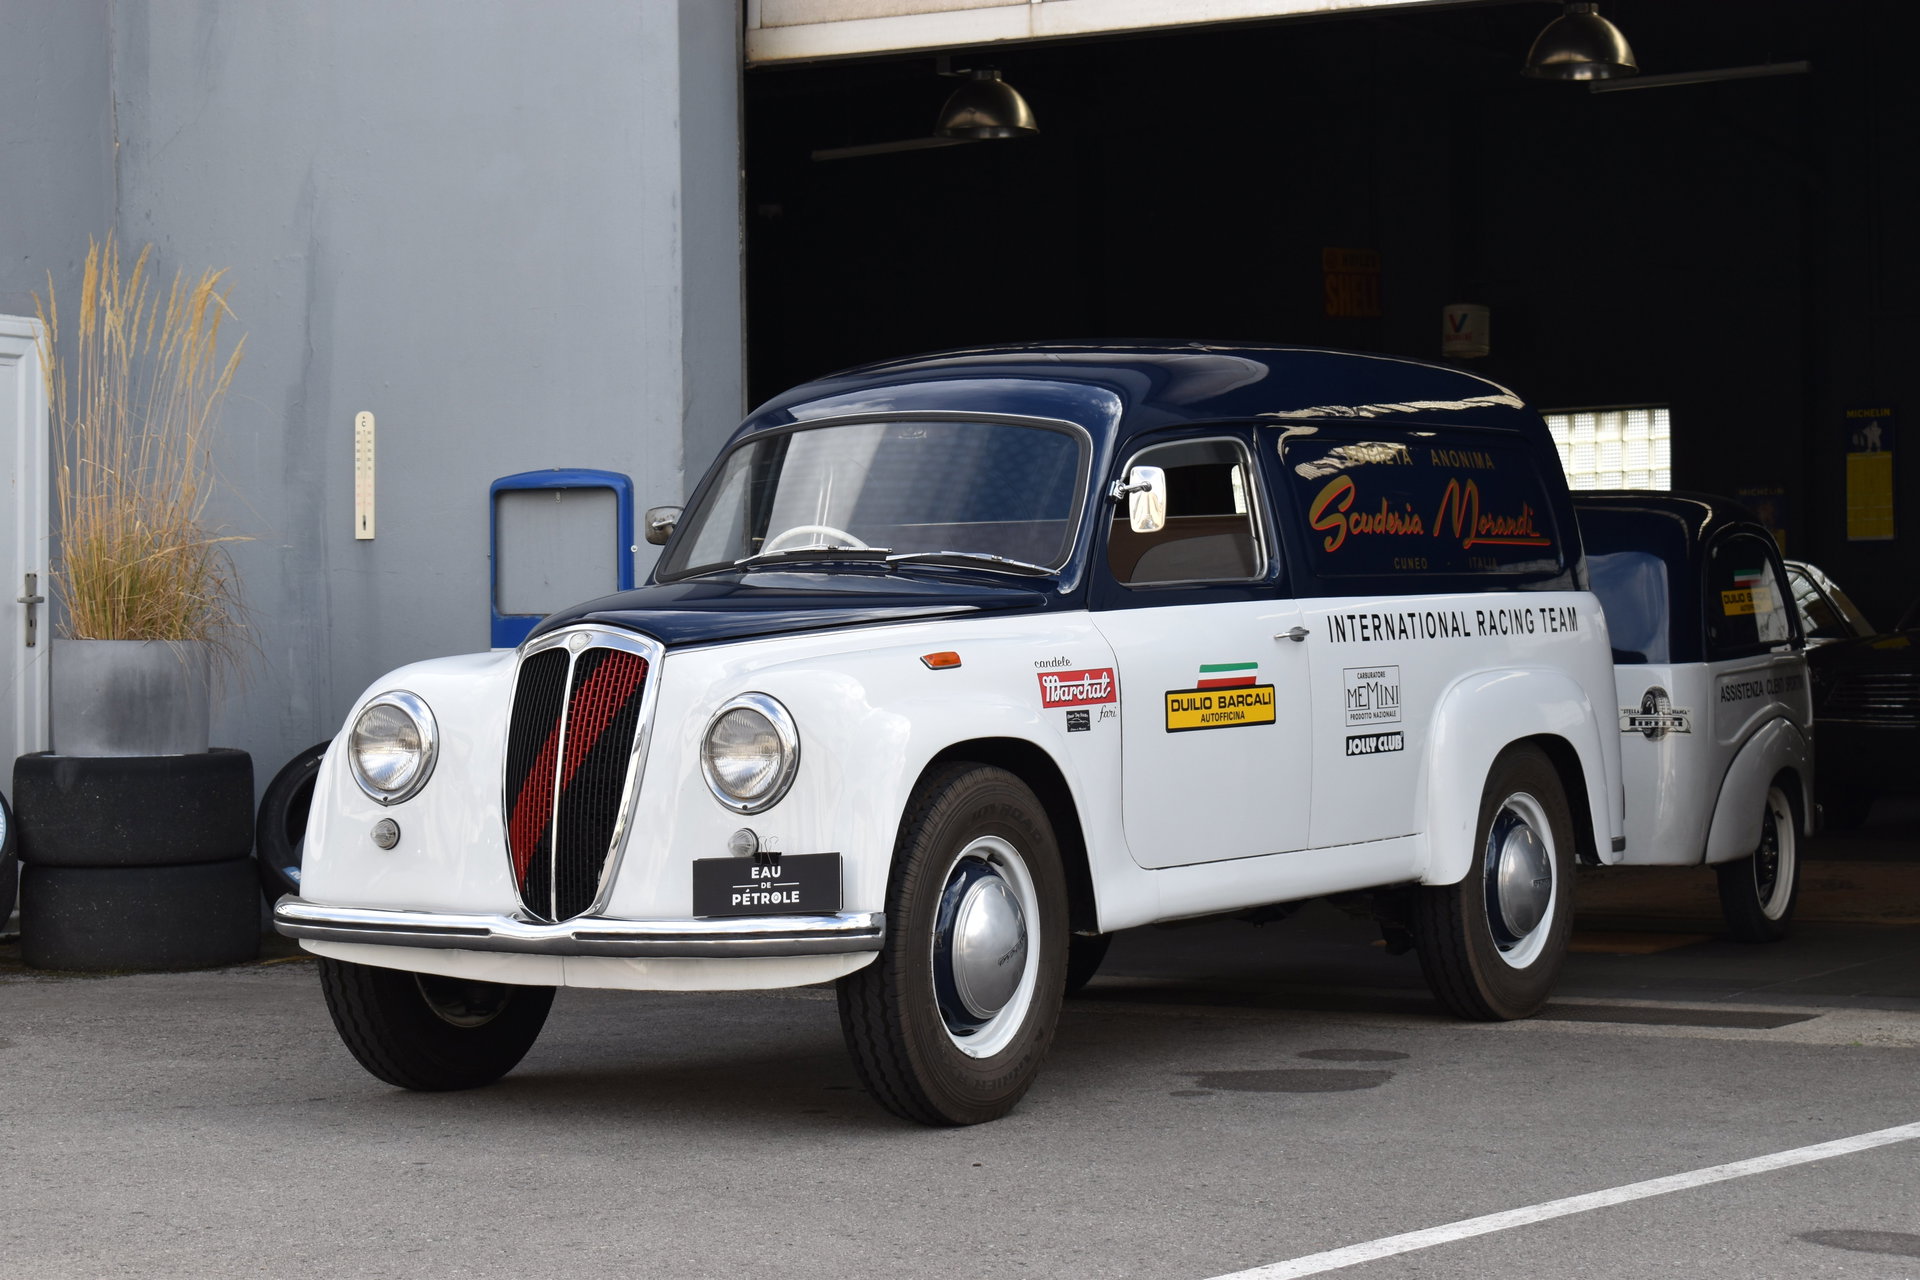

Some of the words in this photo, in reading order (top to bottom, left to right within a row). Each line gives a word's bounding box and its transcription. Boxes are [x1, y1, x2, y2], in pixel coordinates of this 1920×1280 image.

[1846, 408, 1893, 418] MICHELIN
[1431, 449, 1495, 469] ANONIMA
[1309, 474, 1424, 552] Scuderia
[1433, 478, 1551, 549] Morandi
[1393, 556, 1428, 569] CUNEO
[1327, 611, 1471, 643] INTERNATIONAL
[1475, 608, 1535, 636] RACING
[1539, 606, 1579, 633] TEAM
[1034, 656, 1072, 668] candele
[1357, 671, 1386, 679] CARBURATORE
[1042, 671, 1111, 702] Marchal
[1720, 680, 1764, 702] ASSISTENZA
[1171, 697, 1212, 712] DUILIO
[1218, 692, 1271, 709] BARCALI
[1098, 705, 1117, 723] fari
[1201, 711, 1245, 723] AUTOFFICINA
[1350, 712, 1372, 720] PRODOTTO
[1373, 710, 1396, 719] NAZIONALE
[1348, 737, 1377, 755] JOLLY
[1378, 735, 1403, 751] CLUB
[751, 865, 781, 879] EAU
[732, 889, 800, 906] PÉTROLE
